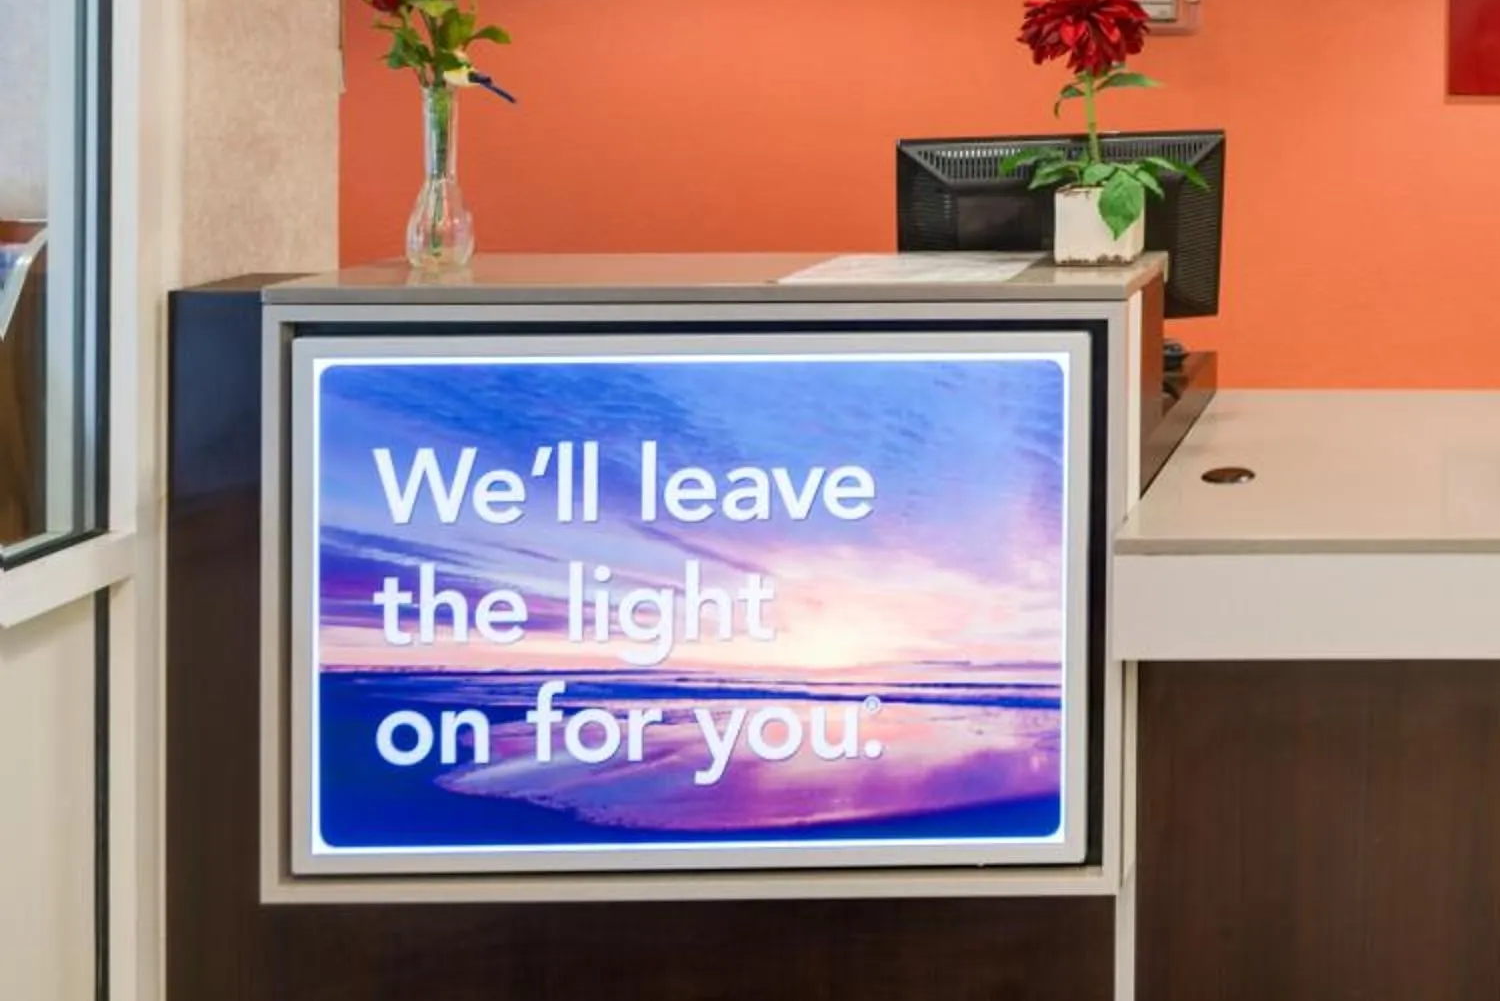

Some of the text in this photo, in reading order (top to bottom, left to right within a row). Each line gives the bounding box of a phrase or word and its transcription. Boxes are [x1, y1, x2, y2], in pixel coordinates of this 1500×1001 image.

[372, 440, 876, 525] We’ll leave
[372, 559, 777, 667] the light
[374, 709, 489, 766] on
[525, 681, 664, 764] for
